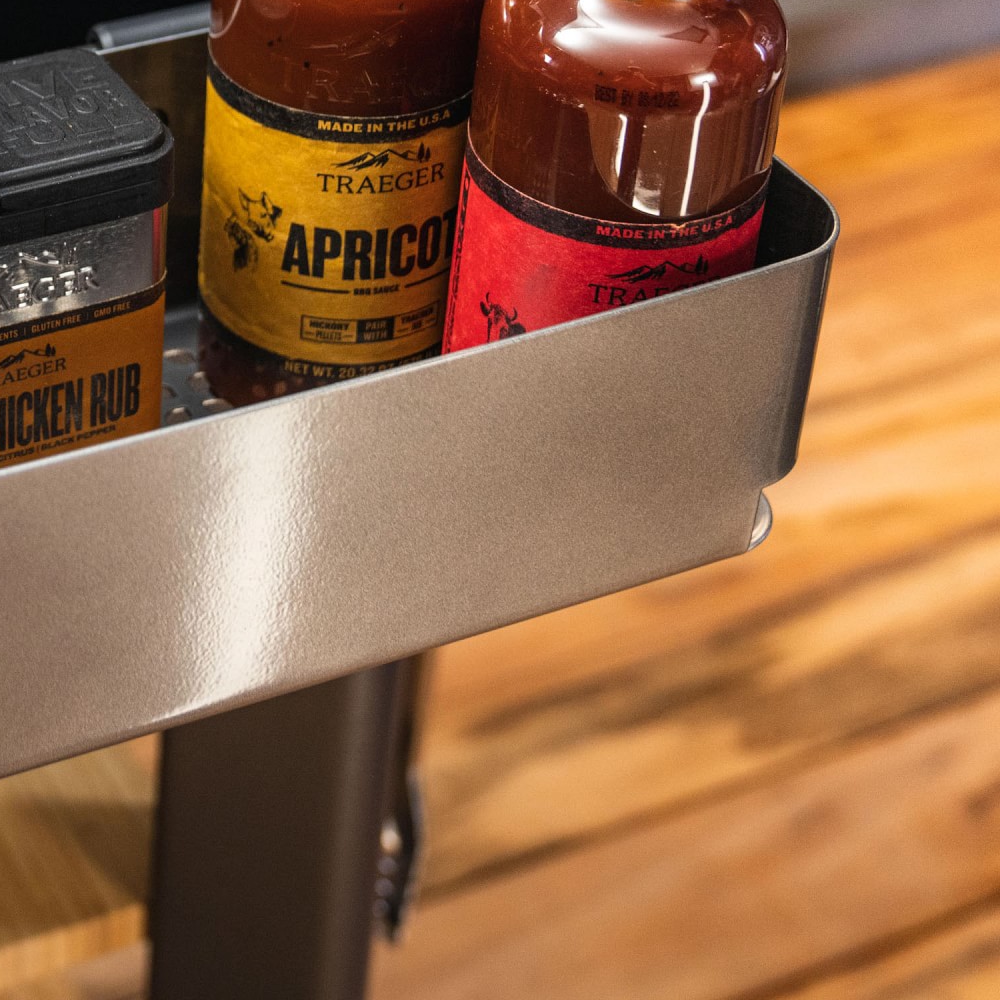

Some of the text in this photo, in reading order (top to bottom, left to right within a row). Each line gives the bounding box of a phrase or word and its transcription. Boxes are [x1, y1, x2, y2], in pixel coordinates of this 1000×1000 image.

[317, 119, 363, 133] MADE
[367, 122, 383, 133] IN
[387, 119, 416, 132] THE
[316, 162, 445, 195] TRAEGER
[596, 225, 643, 239] MADE
[648, 229, 665, 239] IN
[669, 225, 698, 238] THE
[373, 284, 399, 295] SAUCE
[588, 275, 720, 307] TRAE
[31, 318, 61, 333] GLUTEN
[62, 314, 82, 327] FREE
[93, 306, 112, 318] GMO
[113, 301, 131, 314] FREE
[285, 359, 308, 375] NET
[90, 362, 141, 427] RUB
[41, 437, 75, 452] BLACK
[77, 424, 116, 441] PEPPER
